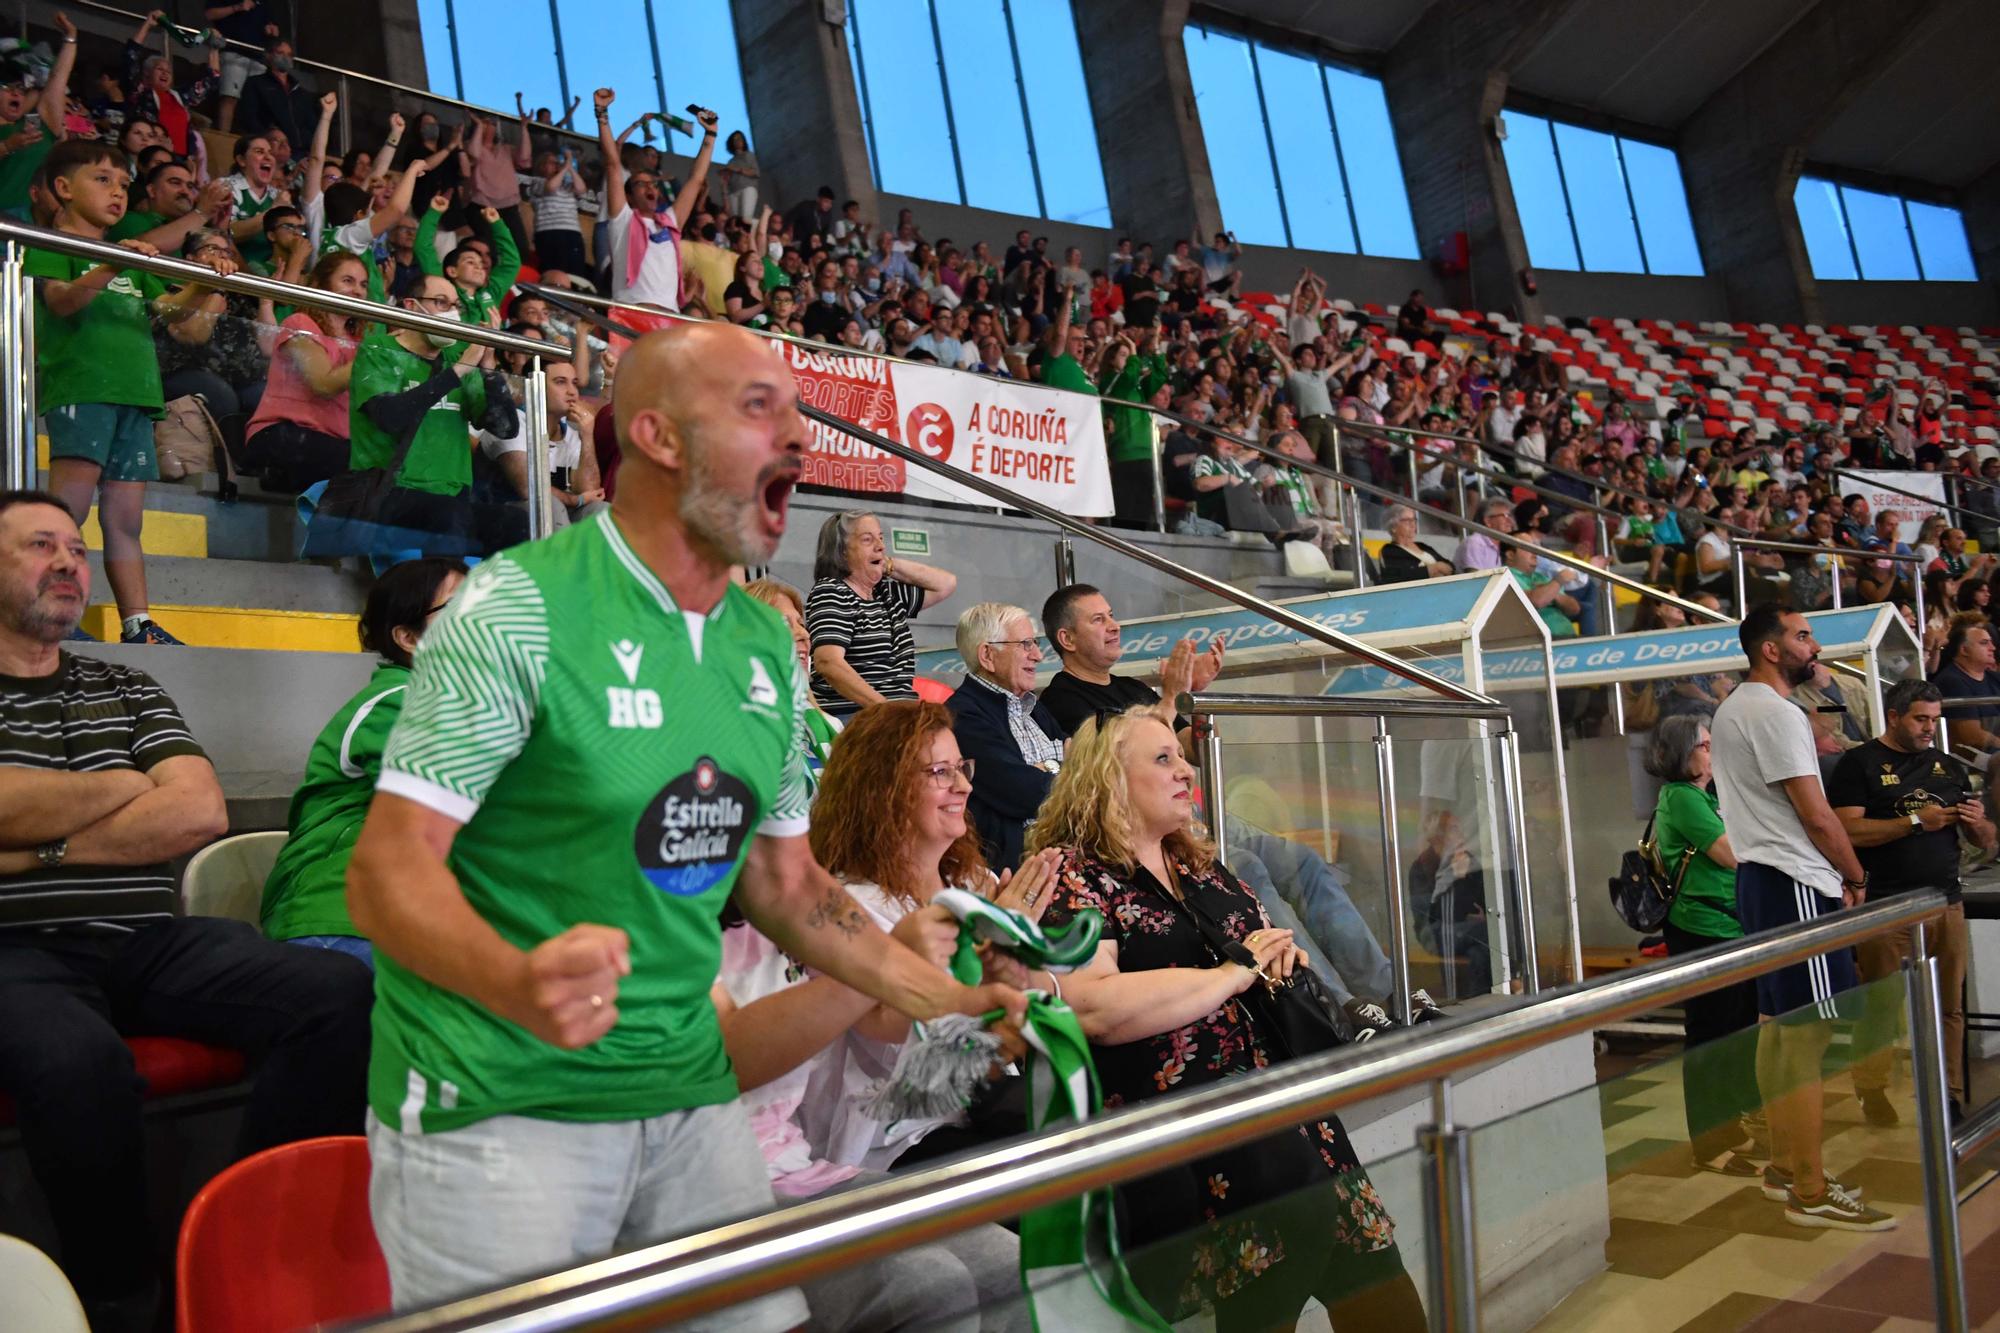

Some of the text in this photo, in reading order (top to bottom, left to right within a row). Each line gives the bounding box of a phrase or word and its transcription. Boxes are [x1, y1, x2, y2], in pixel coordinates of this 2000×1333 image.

[793, 373, 894, 423] PORTES
[967, 402, 1068, 446] A CORUÑA
[797, 456, 898, 493] PORTES
[971, 436, 1076, 485] É DEPORTE
[1586, 647, 1625, 666] de
[606, 686, 664, 729] HG
[661, 794, 744, 828] Estrella
[659, 827, 730, 863] Galicia
